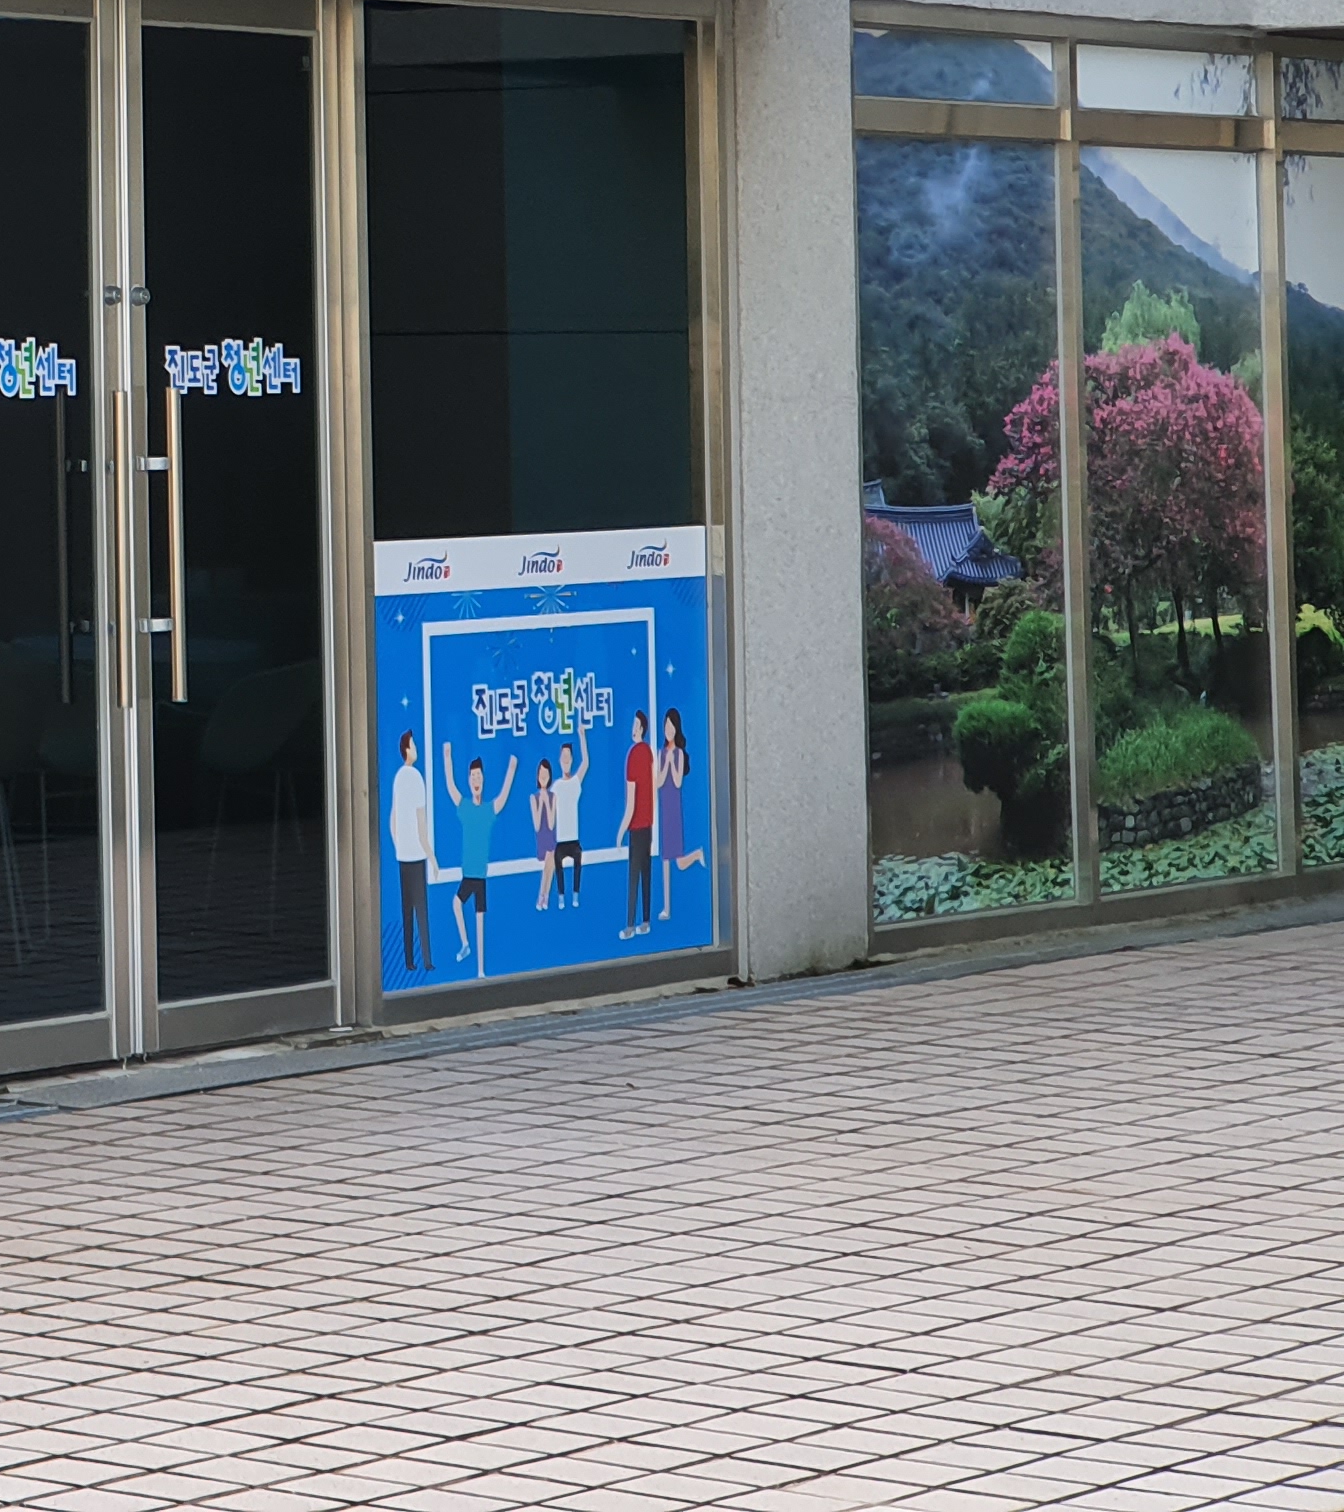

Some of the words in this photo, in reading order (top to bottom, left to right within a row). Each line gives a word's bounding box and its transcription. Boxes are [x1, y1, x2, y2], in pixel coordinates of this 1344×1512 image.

[164, 345, 220, 394] 진도군
[221, 337, 301, 396] 청년센터
[518, 555, 556, 576] Jindo
[627, 549, 664, 570] Jindo
[403, 560, 443, 583] Jindo
[472, 680, 528, 739] 진도군
[531, 667, 613, 734] 청년센터
